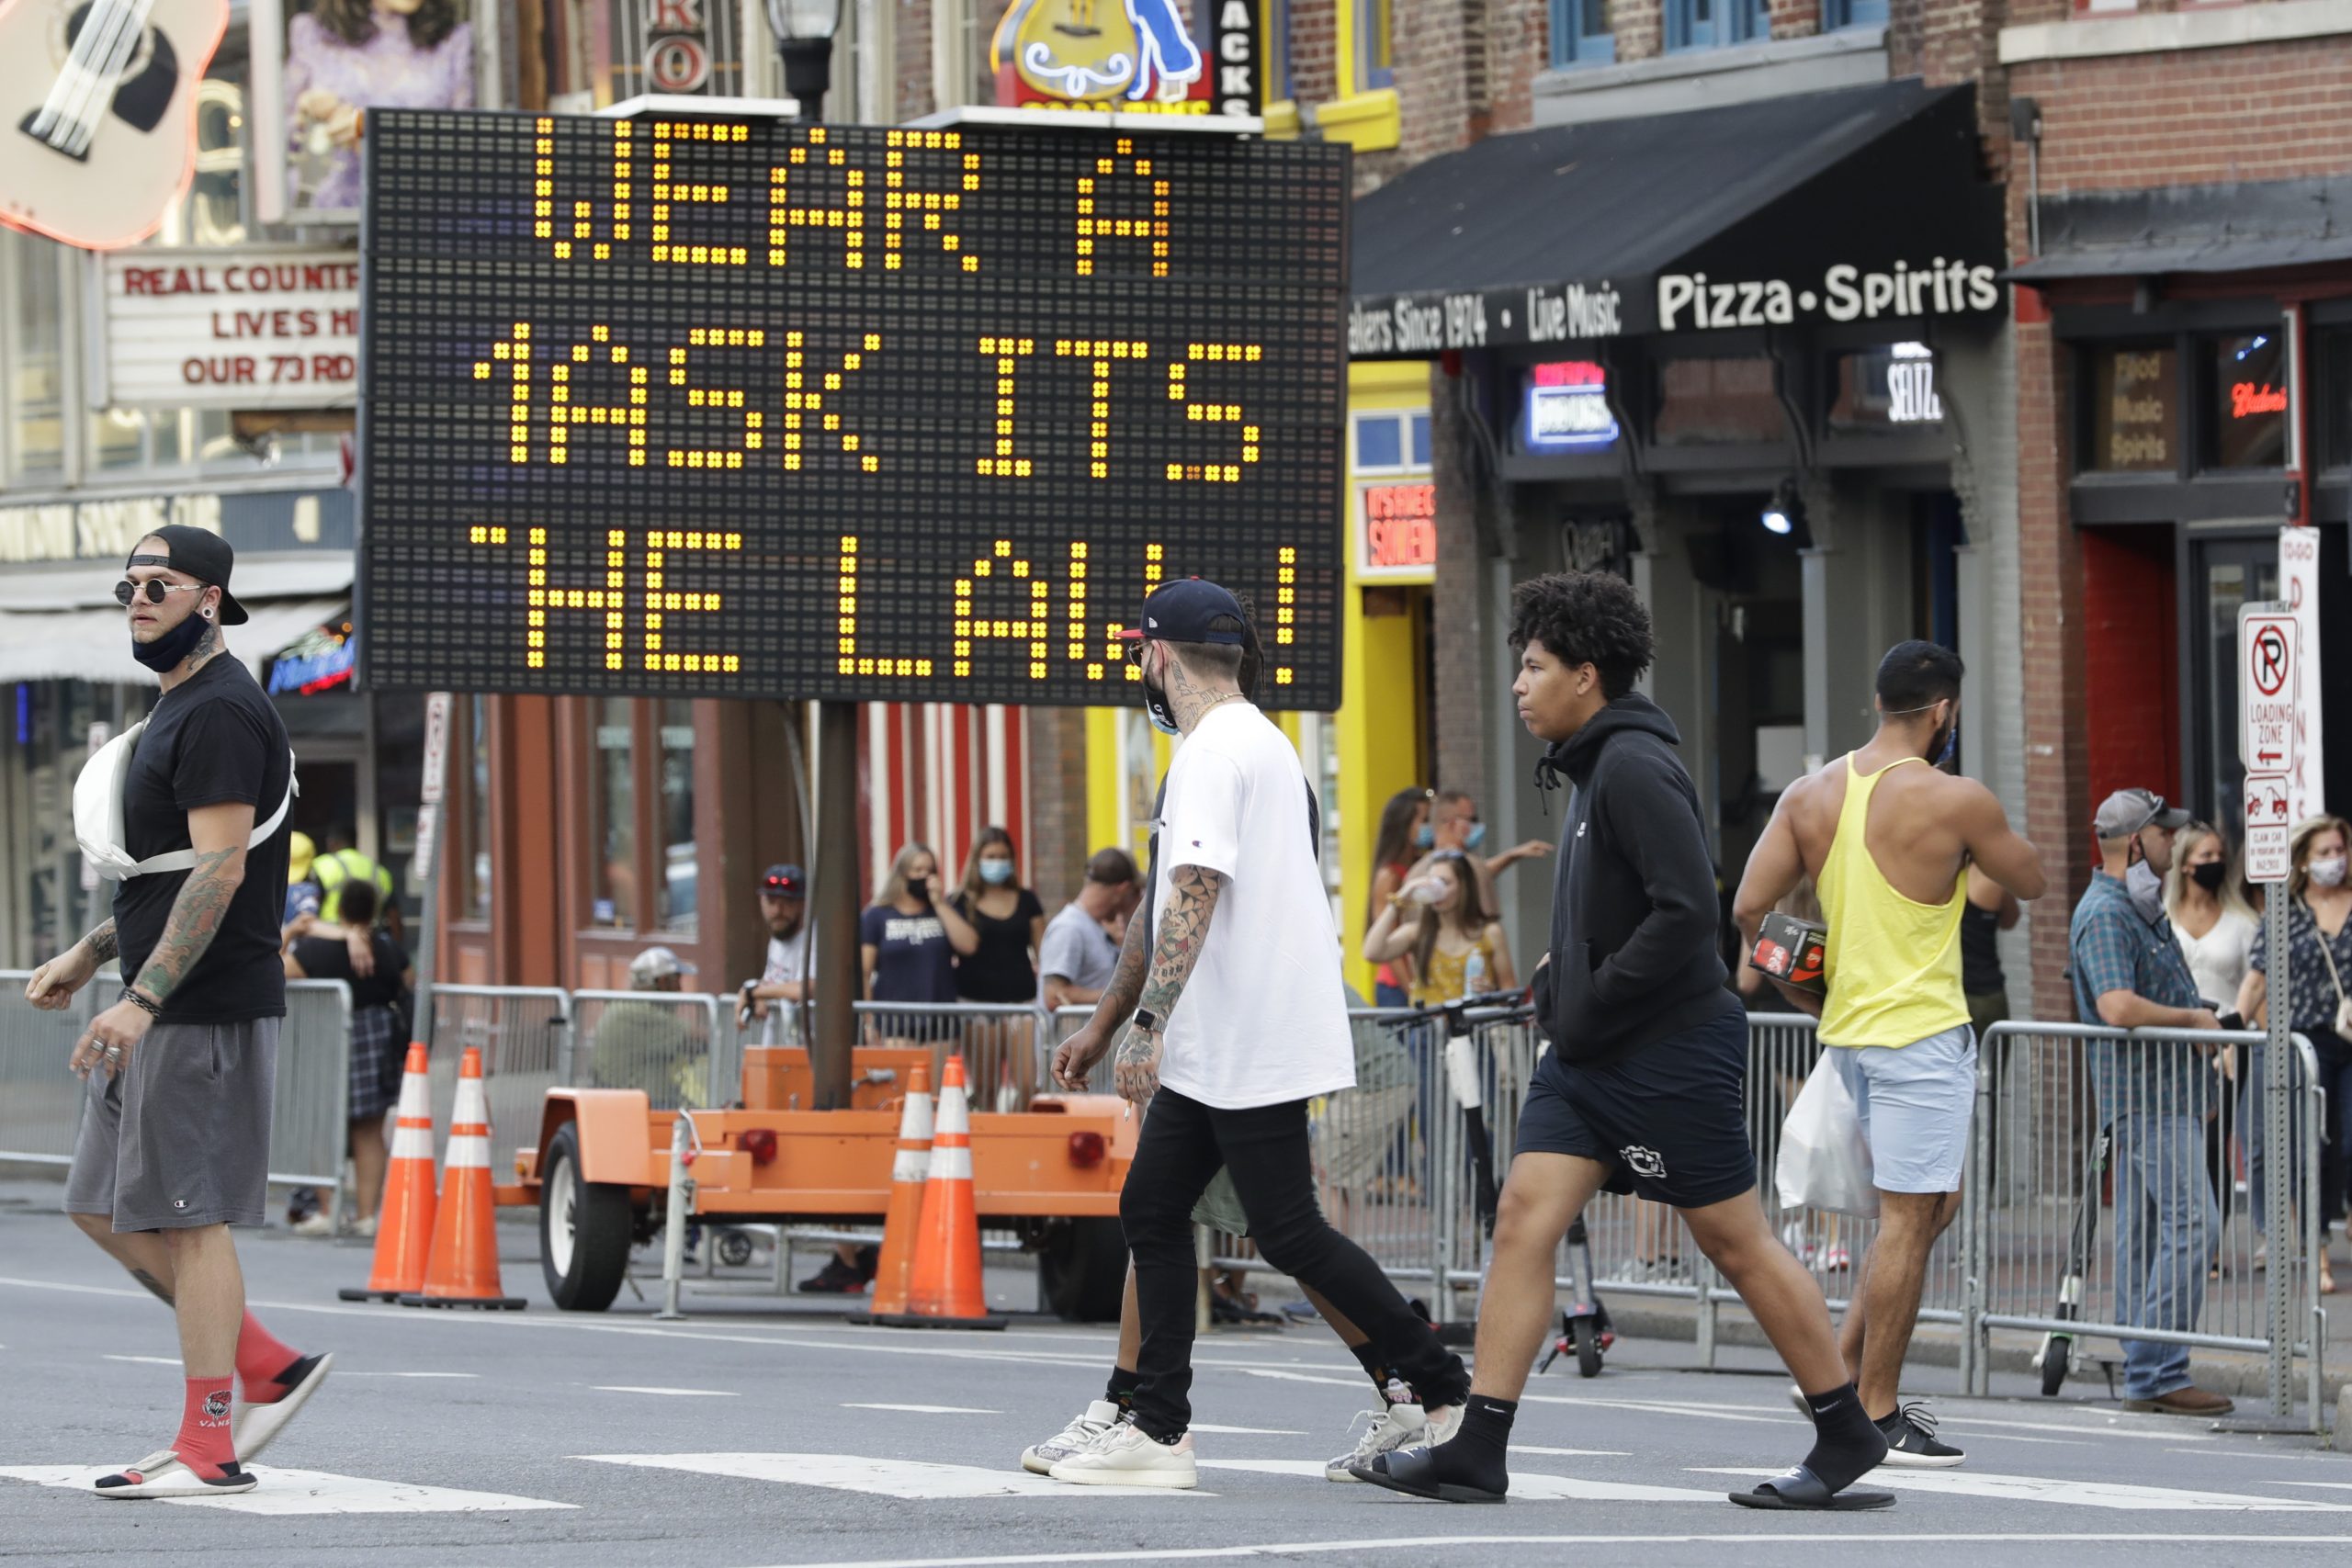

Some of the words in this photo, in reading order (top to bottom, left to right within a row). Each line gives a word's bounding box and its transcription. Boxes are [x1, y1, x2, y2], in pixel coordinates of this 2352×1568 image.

[536, 118, 978, 271] WEAR
[1078, 139, 1168, 276] A
[124, 265, 217, 295] REAL
[1657, 272, 1794, 331] Pizza
[1825, 256, 1998, 321] Spirits
[213, 309, 317, 339] LIVES
[330, 309, 358, 336] H
[1395, 297, 1442, 352] Since
[1527, 287, 1566, 341] Live
[1566, 280, 1622, 338] Music
[184, 356, 256, 384] OUR
[978, 338, 1261, 481] ITS
[471, 527, 741, 671] HE
[2251, 704, 2292, 724] LOADING
[2259, 725, 2284, 744] ZONE
